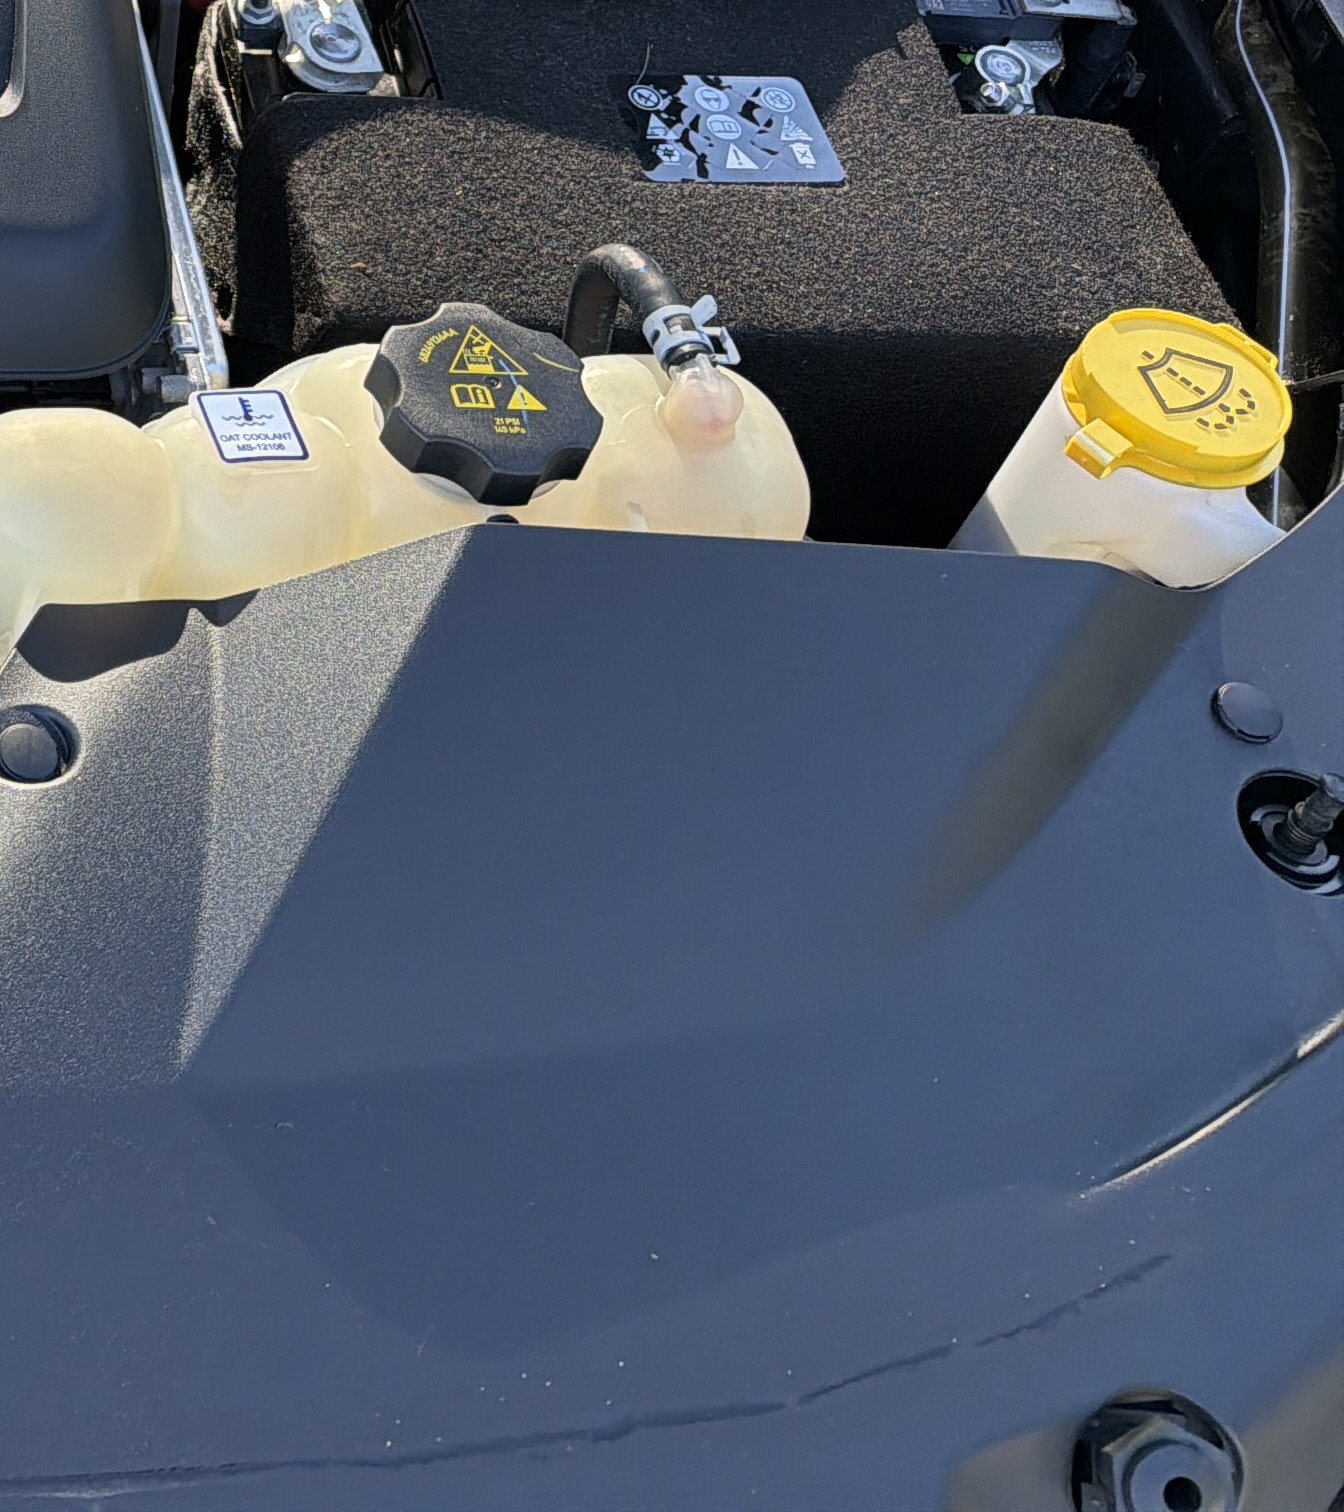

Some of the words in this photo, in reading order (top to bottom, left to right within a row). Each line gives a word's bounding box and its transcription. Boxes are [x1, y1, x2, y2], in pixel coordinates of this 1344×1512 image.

[505, 417, 520, 426] PSI
[220, 434, 240, 442] OAT
[242, 432, 292, 441] COOLANT
